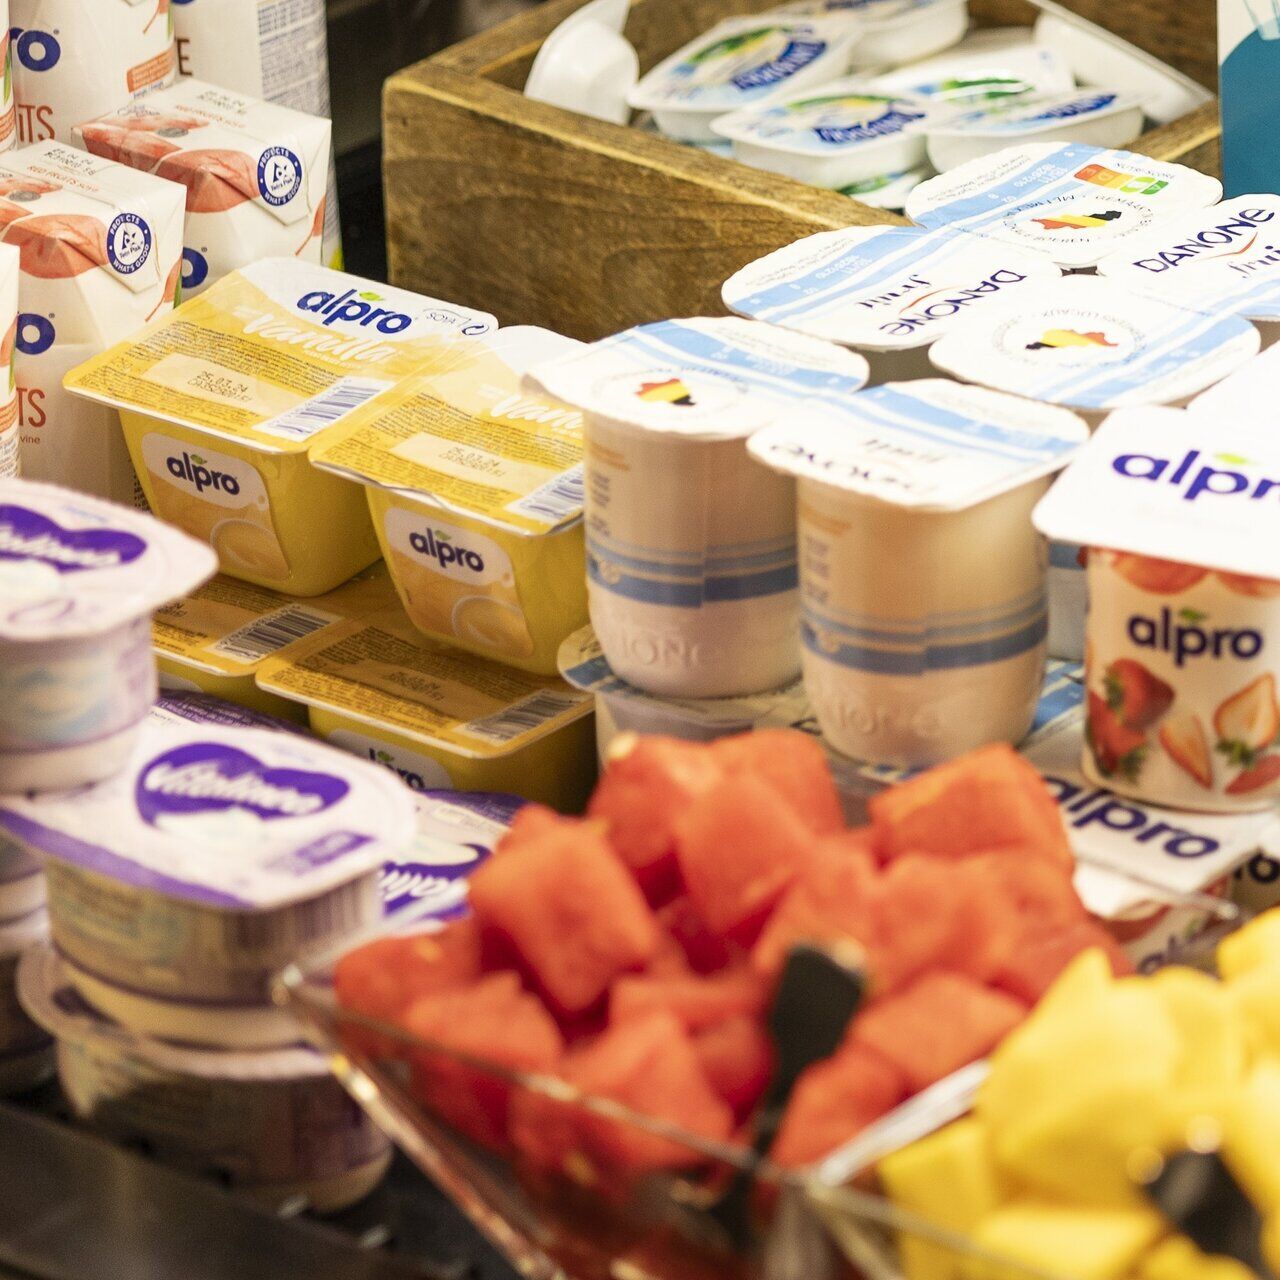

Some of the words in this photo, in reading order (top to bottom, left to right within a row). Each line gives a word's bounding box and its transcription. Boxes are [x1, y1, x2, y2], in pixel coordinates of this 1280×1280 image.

[297, 289, 412, 334] alpro
[243, 312, 398, 362] Vanilla
[166, 451, 240, 497] alpro
[408, 526, 484, 574] alpro
[1127, 605, 1264, 668] alpro
